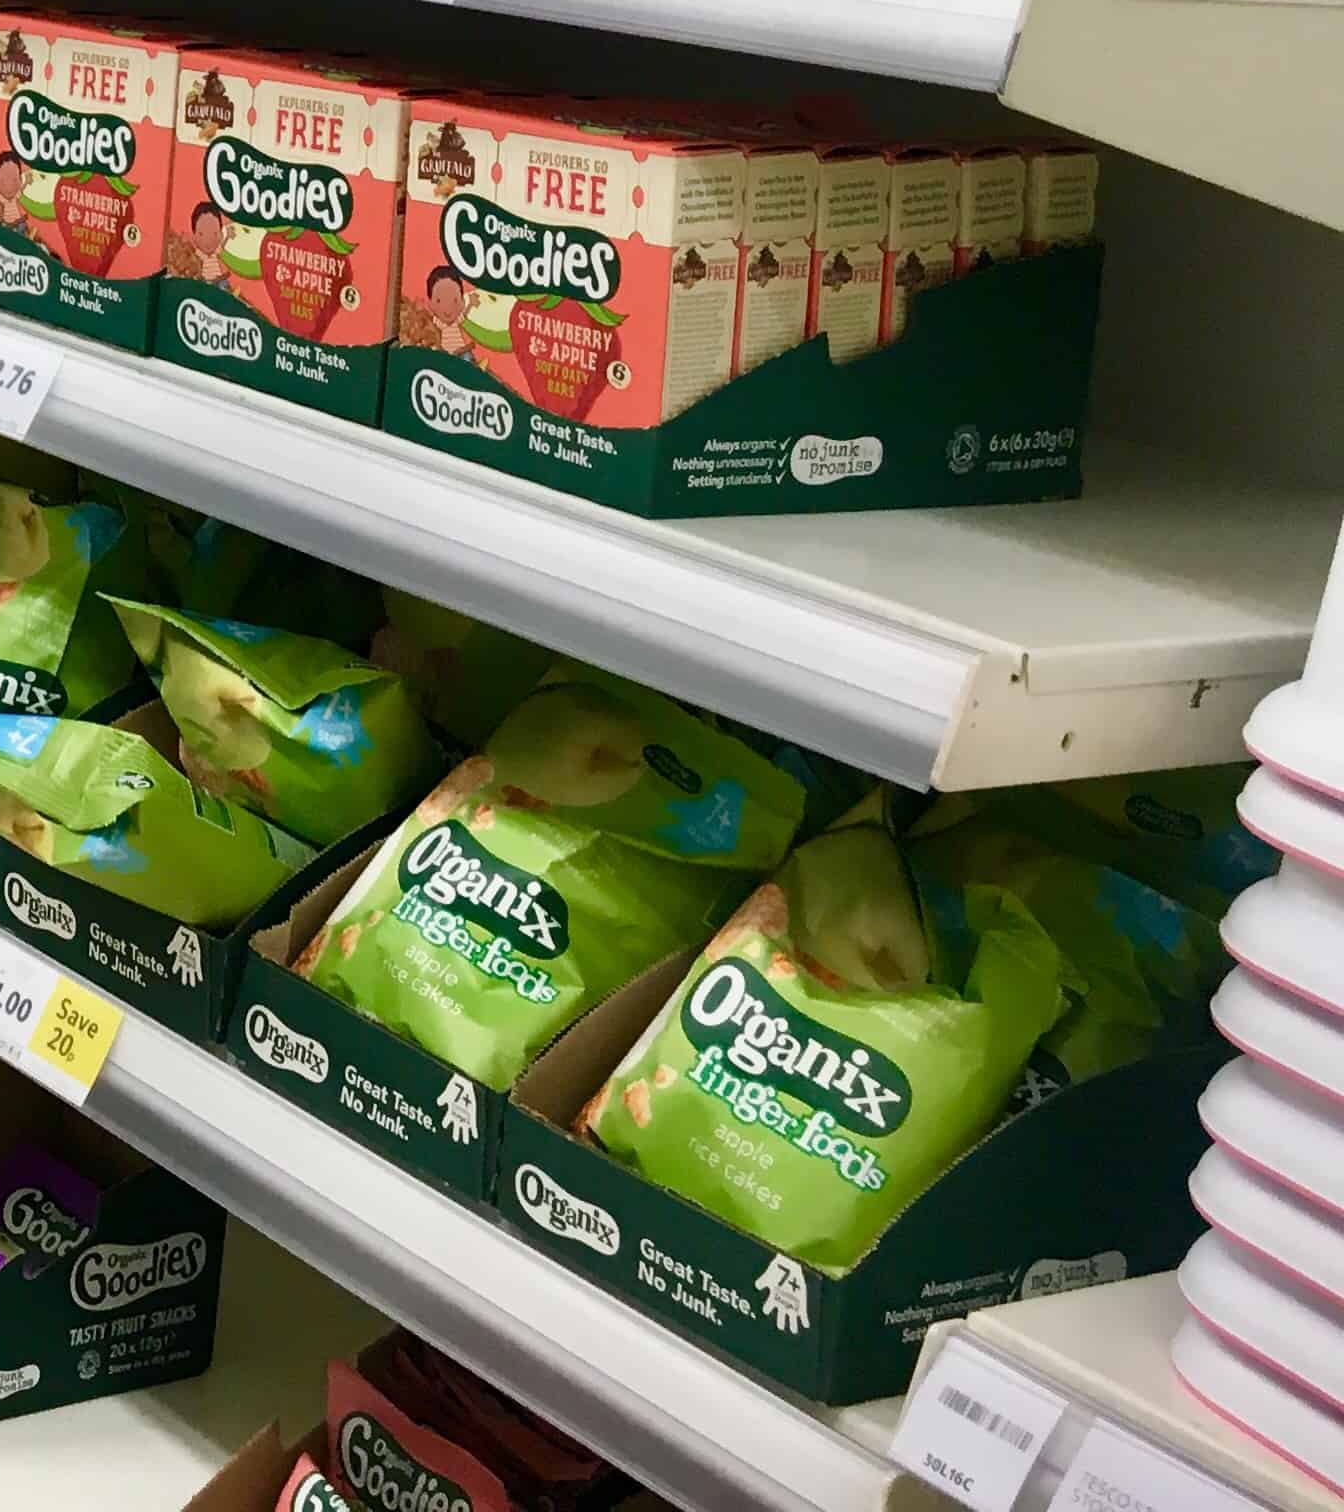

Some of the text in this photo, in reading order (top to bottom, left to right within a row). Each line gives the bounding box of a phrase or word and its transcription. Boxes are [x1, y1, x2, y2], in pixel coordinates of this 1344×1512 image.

[275, 110, 343, 154] FREE
[528, 150, 608, 173] EXPLORERS GO
[207, 142, 348, 231] Goodies
[526, 165, 608, 216] FREE
[484, 213, 537, 243] Organix
[266, 241, 346, 278] STRAWBERRY
[444, 201, 615, 299] Goodies
[517, 310, 612, 351] STRAWBERRY
[550, 345, 598, 371] APPLE
[612, 365, 626, 381] 6
[528, 434, 593, 469] No Junk.
[529, 414, 618, 456] Great Taste.
[821, 442, 860, 461] junk
[672, 456, 716, 472] Nothing
[809, 458, 873, 478] promise
[407, 826, 562, 953] Organix
[88, 922, 127, 956] Great
[391, 883, 558, 1003] finger foods
[88, 941, 147, 988] No Junk.
[55, 997, 100, 1040] Save
[46, 1026, 76, 1064] 20p
[248, 1008, 327, 1078] Organix
[688, 963, 903, 1131] Organix
[453, 1081, 472, 1108] 7+
[687, 1044, 887, 1192] finger foods
[713, 1121, 775, 1171] apple
[723, 1157, 785, 1214] cakes
[520, 1167, 616, 1250] Organix
[637, 1260, 724, 1327] No Junk.
[639, 1237, 757, 1321] Great Taste.
[775, 1263, 801, 1292] 7+
[69, 1304, 197, 1347] TASTY FRUIT SNACKS
